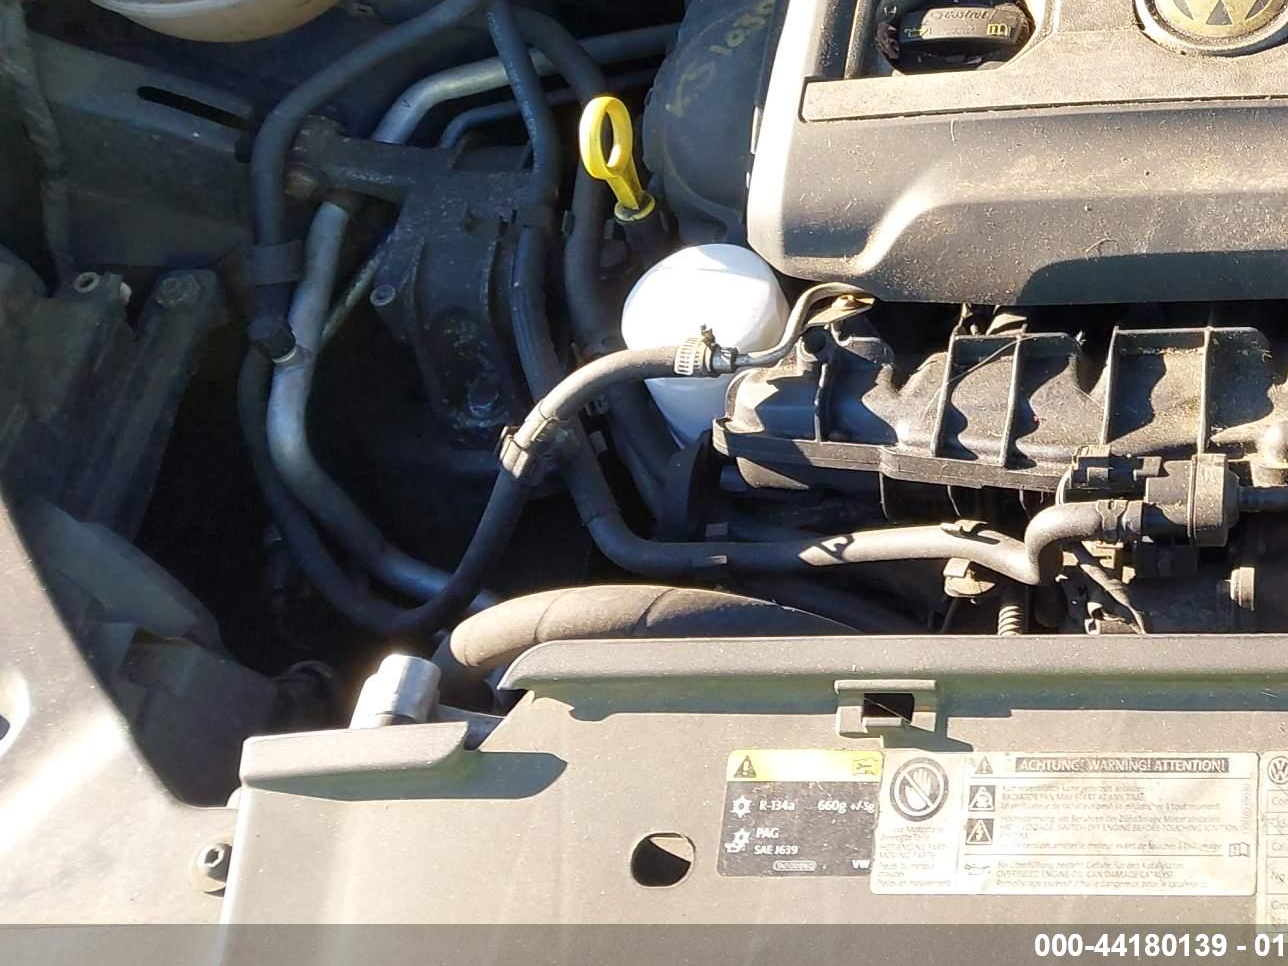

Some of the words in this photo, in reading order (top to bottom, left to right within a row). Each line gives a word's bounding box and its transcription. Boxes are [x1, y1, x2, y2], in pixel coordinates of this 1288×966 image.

[1087, 759, 1151, 771] WARNING!
[1155, 759, 1225, 771] ATTENTION!
[759, 800, 796, 811] R-134a
[817, 800, 847, 813] 660g
[756, 828, 780, 838] PAG
[754, 845, 773, 855] SAE
